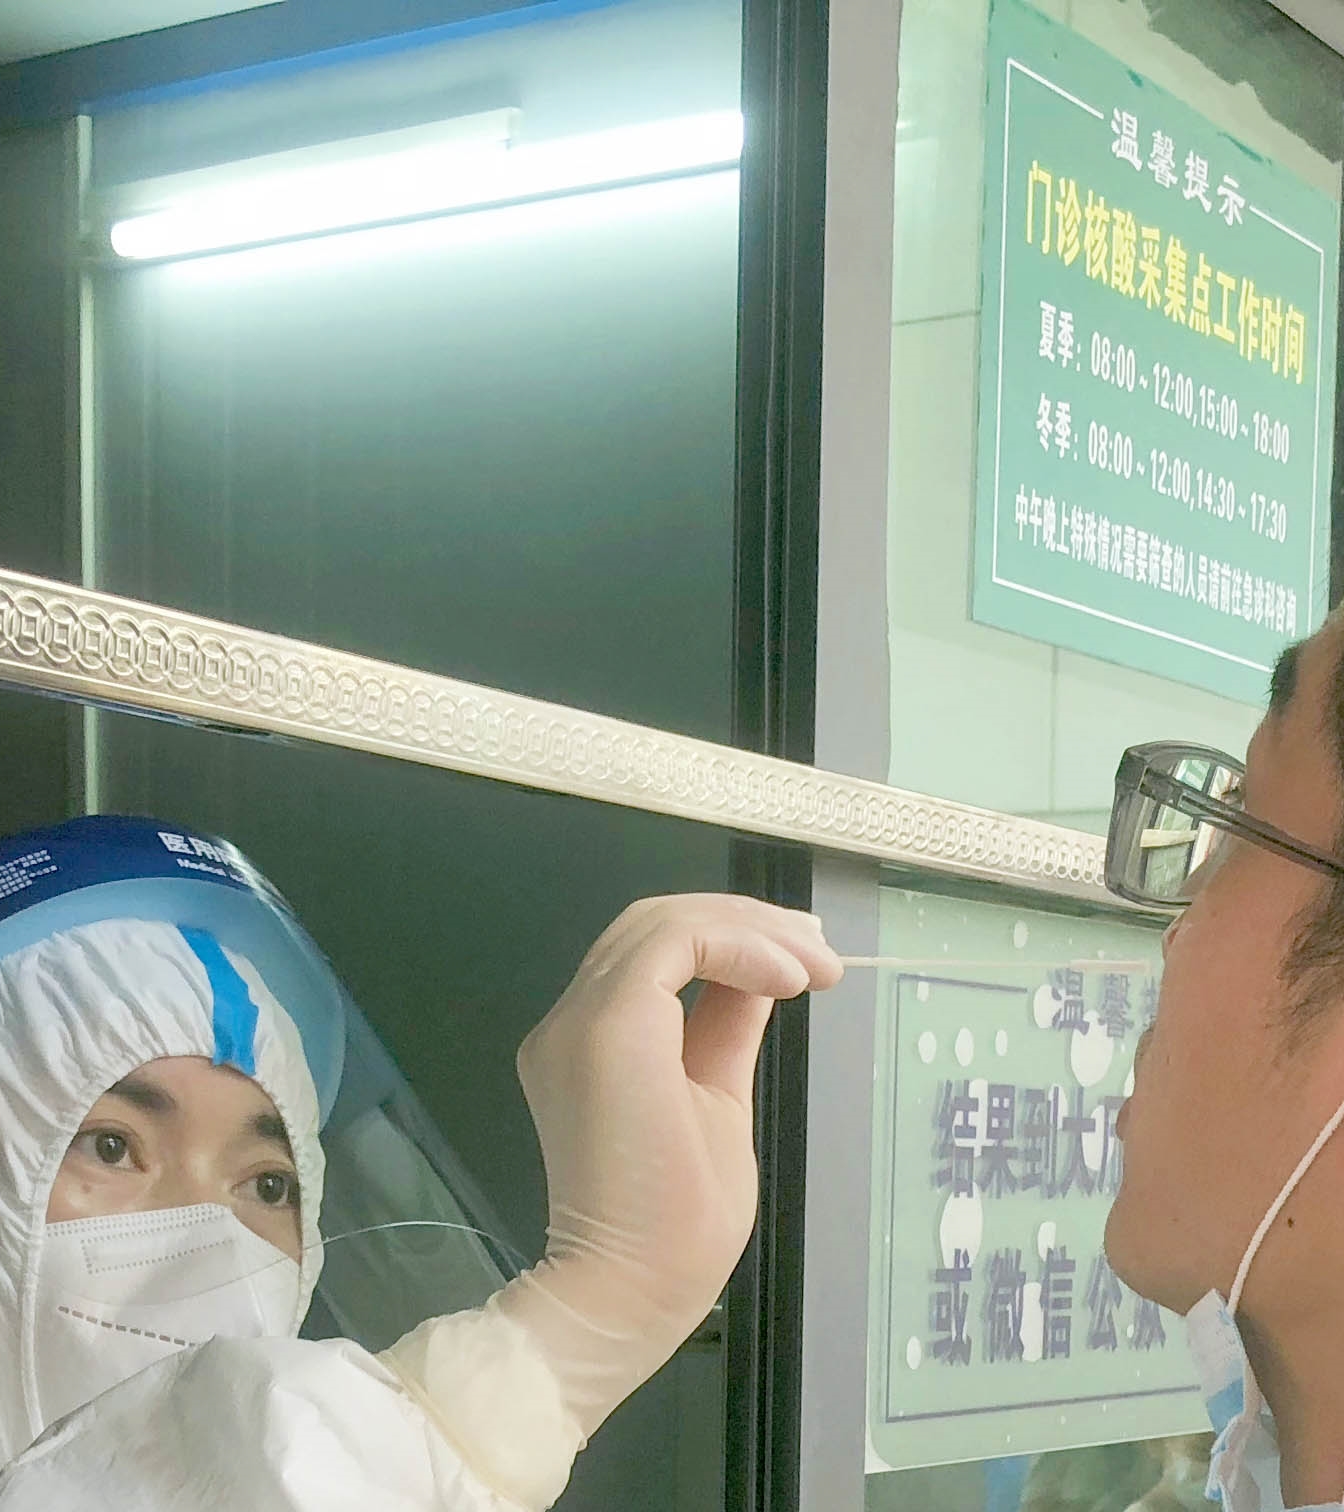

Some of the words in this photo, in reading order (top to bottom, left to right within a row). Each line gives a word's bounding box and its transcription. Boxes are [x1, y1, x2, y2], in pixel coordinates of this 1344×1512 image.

[1111, 106, 1246, 227] 温馨提示
[1024, 160, 1306, 385] 门诊核酸采集点工作时间
[1014, 484, 1297, 638] 中午晚上特殊情况需要筛查的人员请前往急诊科咨询
